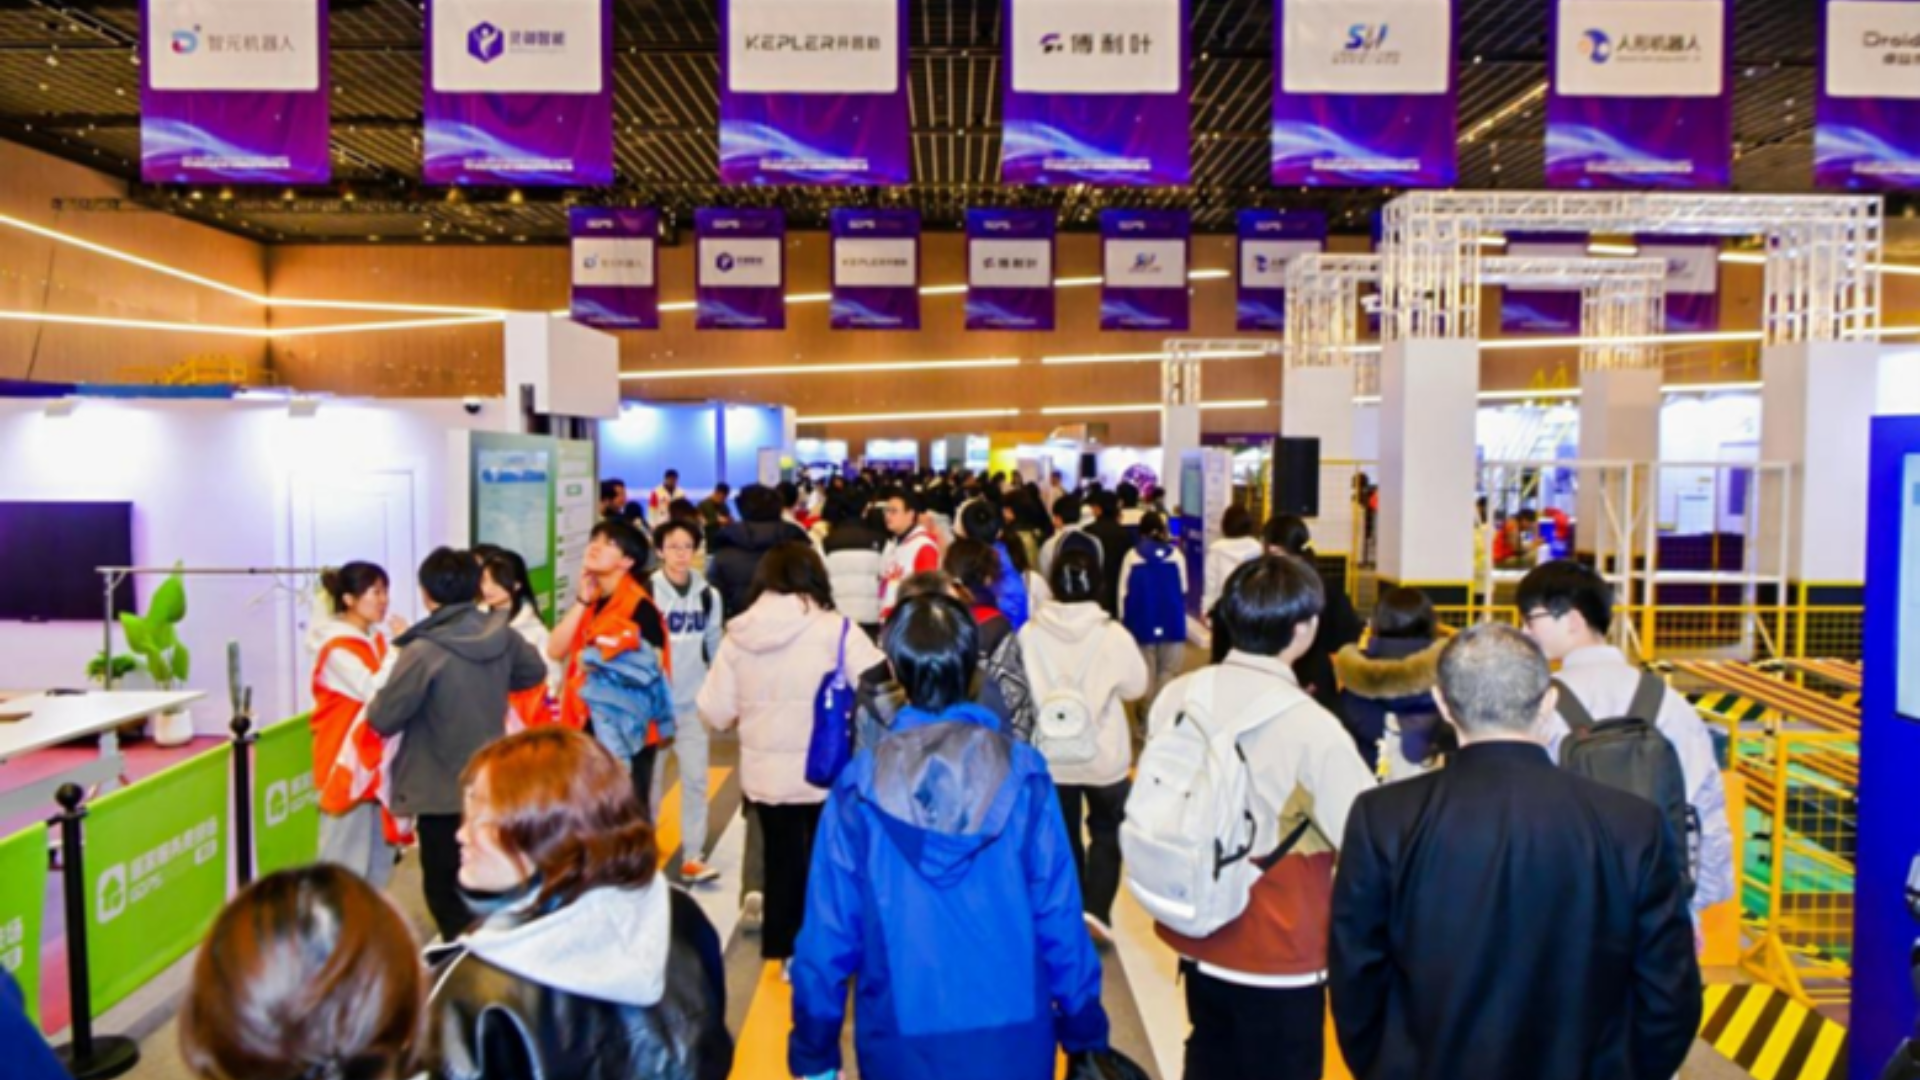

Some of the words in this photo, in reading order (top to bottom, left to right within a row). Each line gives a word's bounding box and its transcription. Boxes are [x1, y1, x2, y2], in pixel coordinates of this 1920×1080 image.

[208, 34, 296, 53] 智元机器人
[1616, 33, 1702, 52] 人形机器人
